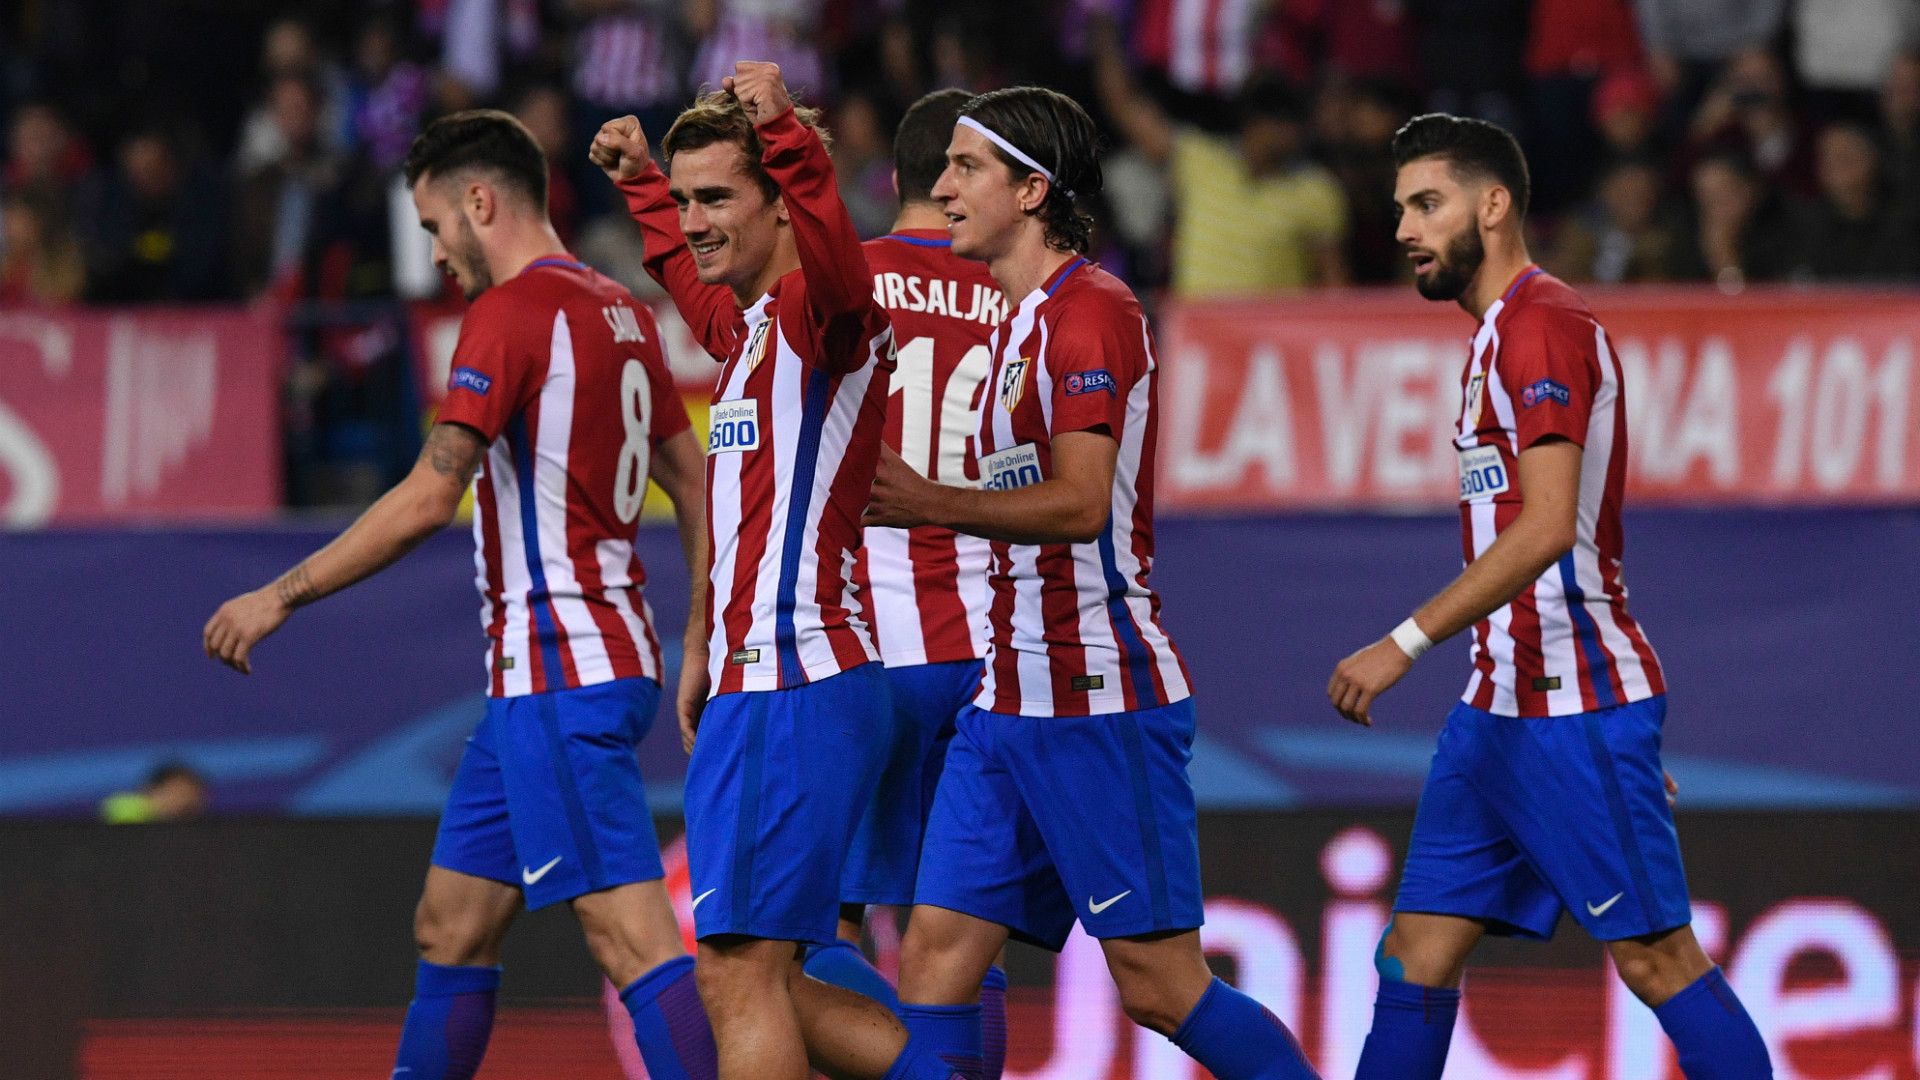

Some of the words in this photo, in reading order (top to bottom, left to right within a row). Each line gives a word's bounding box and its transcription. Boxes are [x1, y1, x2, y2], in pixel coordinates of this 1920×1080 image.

[873, 272, 1009, 327] RSALJK
[1084, 373, 1117, 394] RESP
[728, 406, 754, 419] Online
[1173, 341, 1296, 492] LA
[1766, 334, 1912, 493] 101
[613, 358, 652, 525] 8
[1005, 452, 1035, 467] Online
